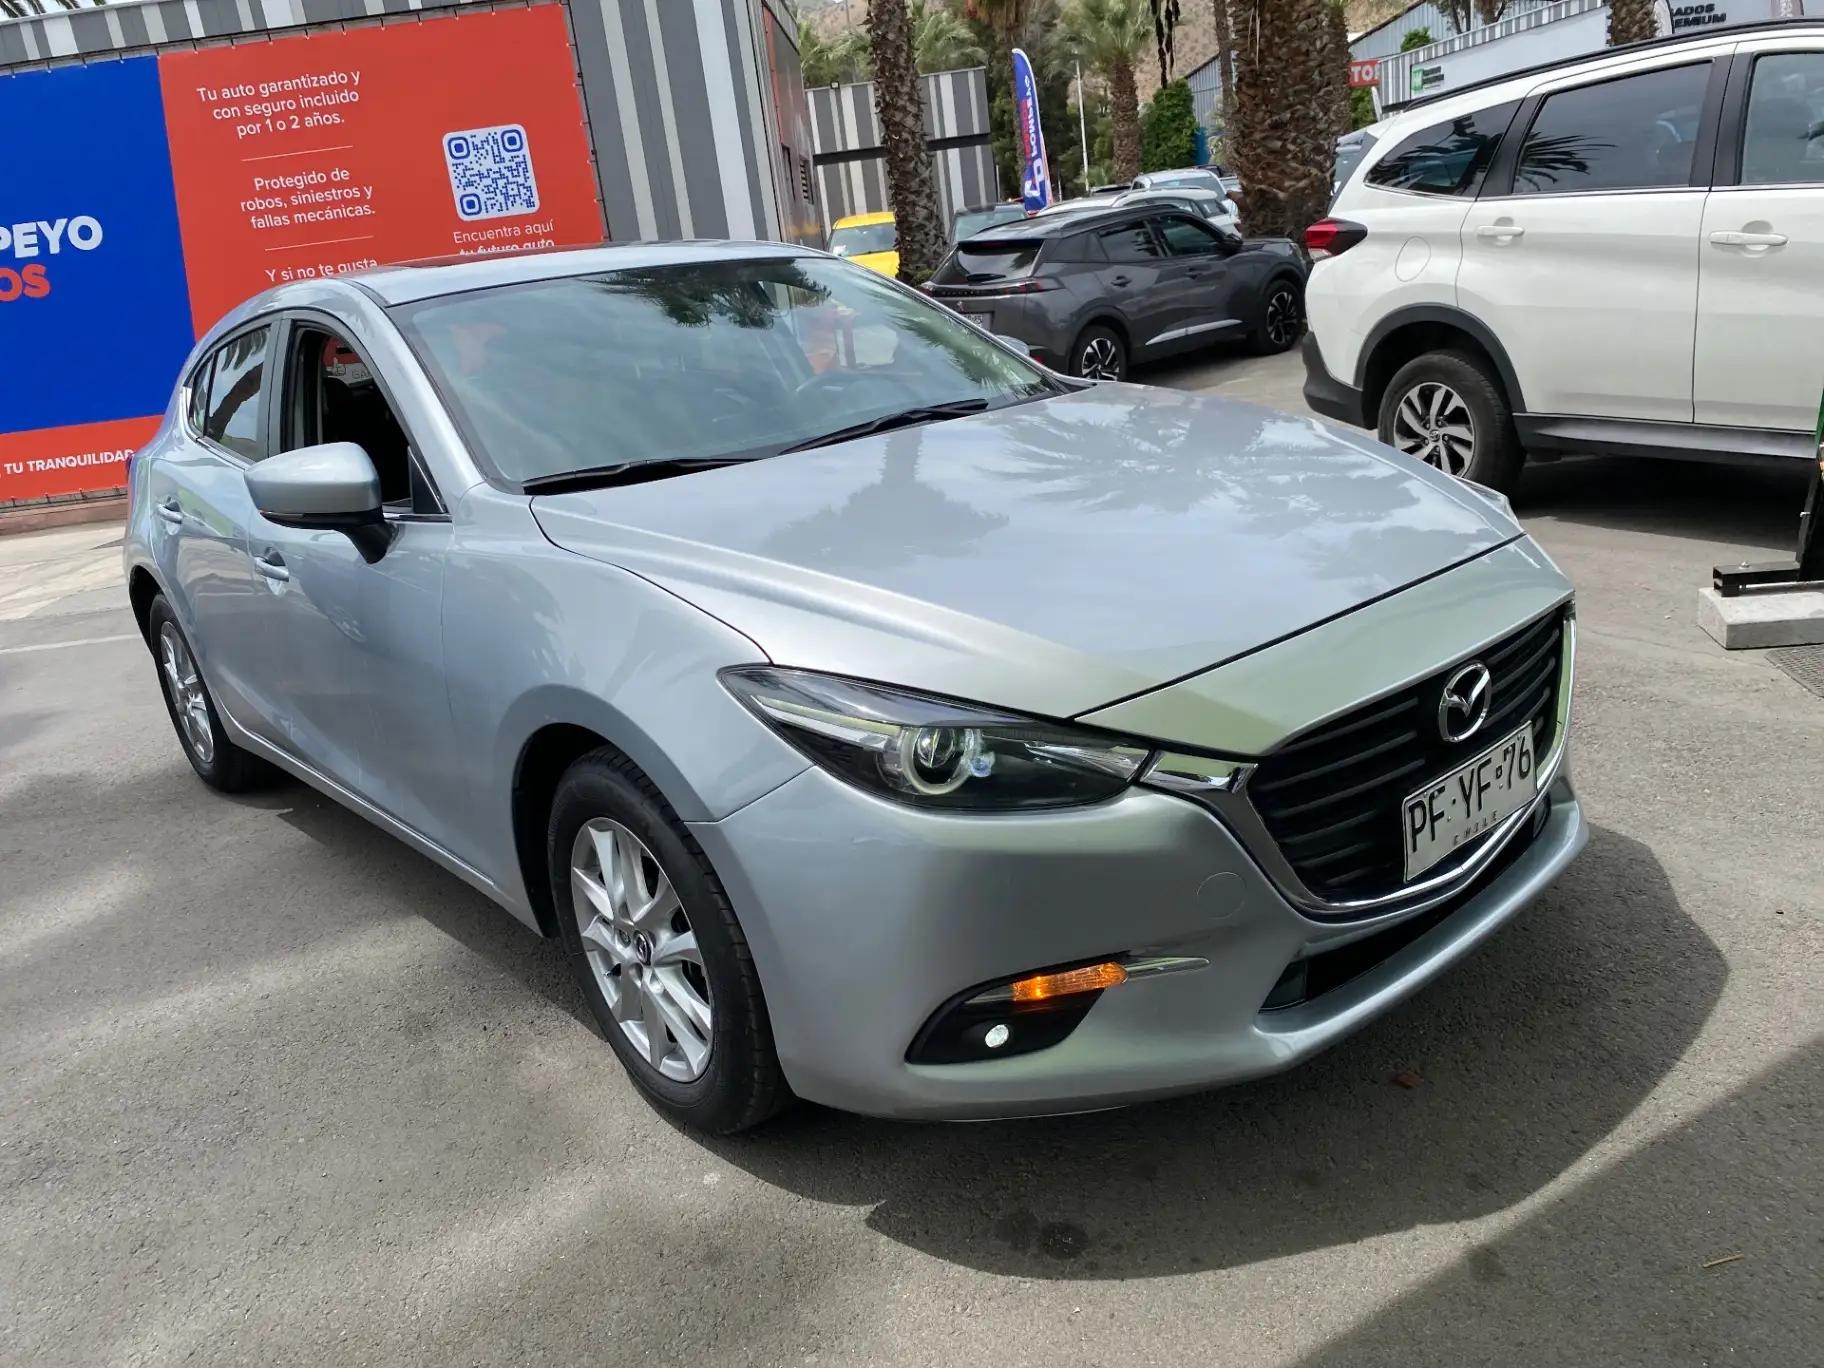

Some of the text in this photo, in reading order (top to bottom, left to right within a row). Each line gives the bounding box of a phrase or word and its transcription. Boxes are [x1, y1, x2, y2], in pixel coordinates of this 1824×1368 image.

[1671, 3, 1715, 16] ADOS
[1672, 13, 1727, 28] EMIUM
[196, 71, 361, 102] Tu auto garantizado y
[213, 89, 360, 120] con seguro incluido
[236, 112, 345, 139] por 1 o 2 años.
[254, 167, 351, 191] Protegido de
[240, 185, 374, 212] robos, siniestros y
[250, 204, 376, 229] fallas mecánicas.
[453, 219, 555, 244] Encuentra aquí
[264, 269, 277, 282] Y
[281, 266, 294, 281] si
[297, 266, 316, 279] no
[318, 262, 334, 277] te
[4, 461, 24, 475] TU
